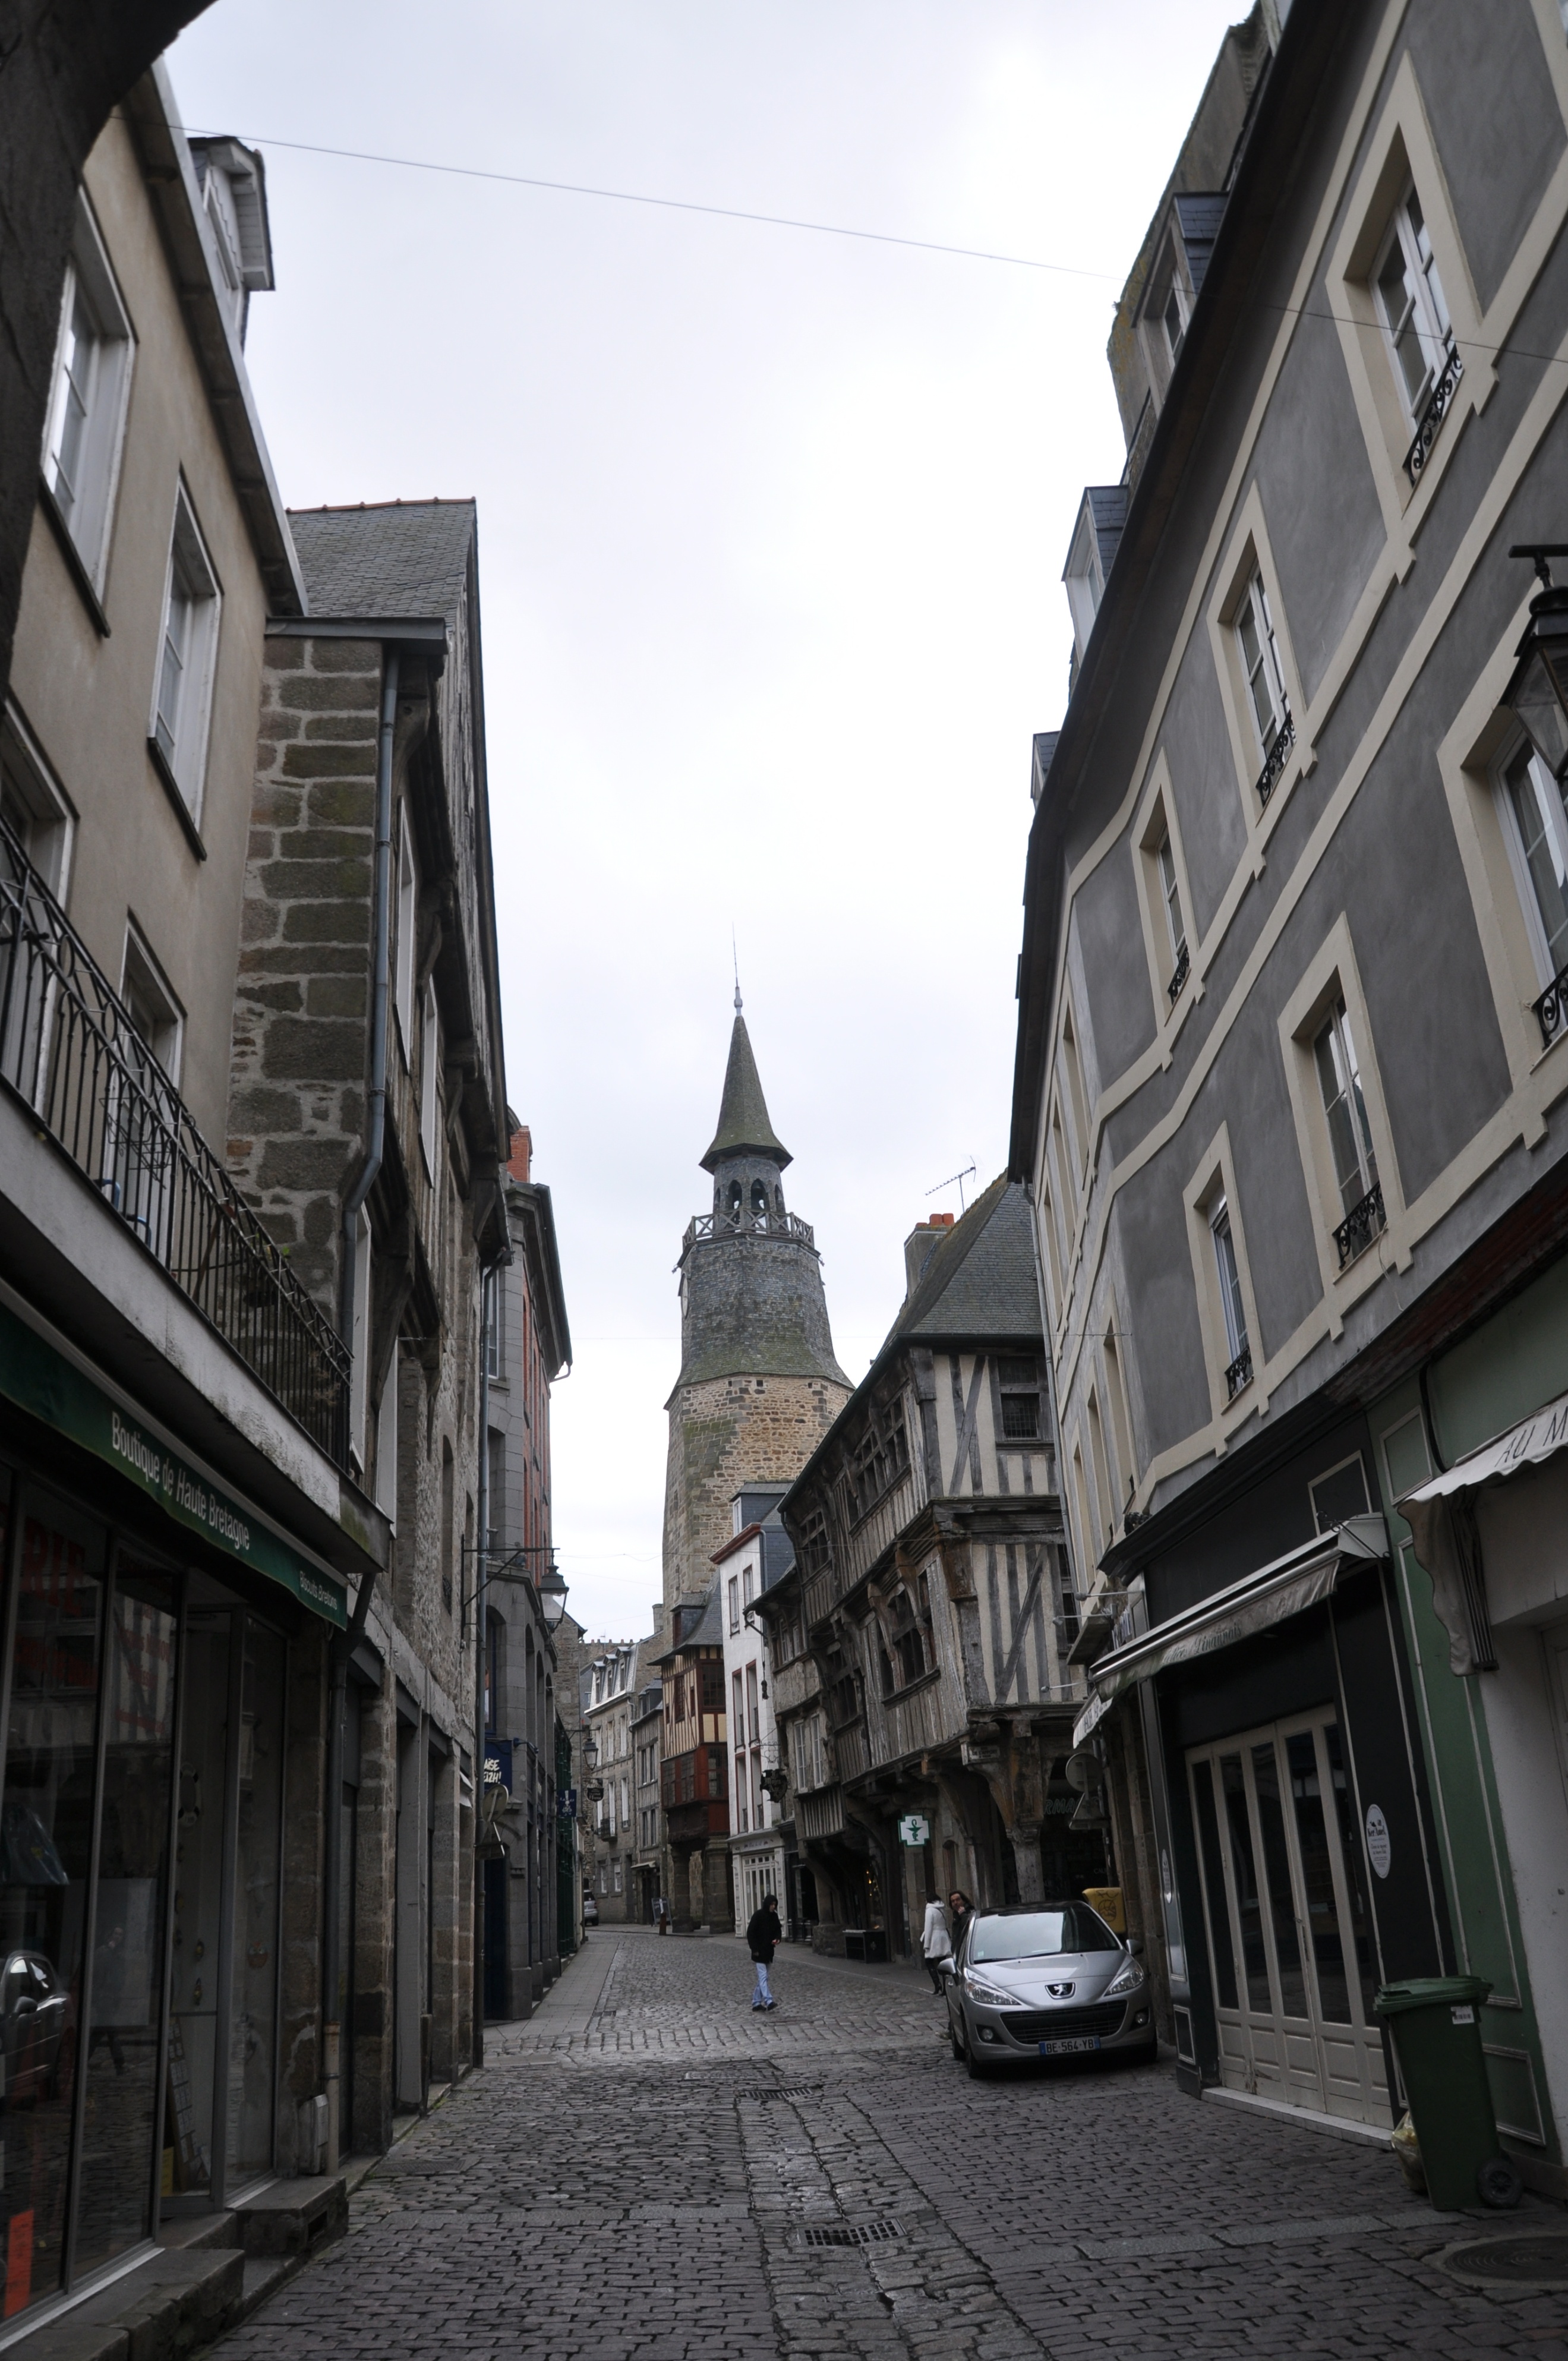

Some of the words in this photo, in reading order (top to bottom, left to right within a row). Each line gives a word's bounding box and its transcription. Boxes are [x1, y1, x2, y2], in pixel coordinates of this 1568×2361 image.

[1494, 1424, 1536, 1467] AU
[1542, 1405, 1568, 1446] M
[111, 1411, 160, 1484] Boutique
[162, 1457, 174, 1496] de
[176, 1468, 207, 1520] Haute
[209, 1493, 250, 1550] Bretagne
[20, 1515, 86, 1618] RIE
[299, 1570, 318, 1599] Biscuits
[318, 1584, 337, 1610] Bretons
[1044, 1797, 1077, 1815] RMA
